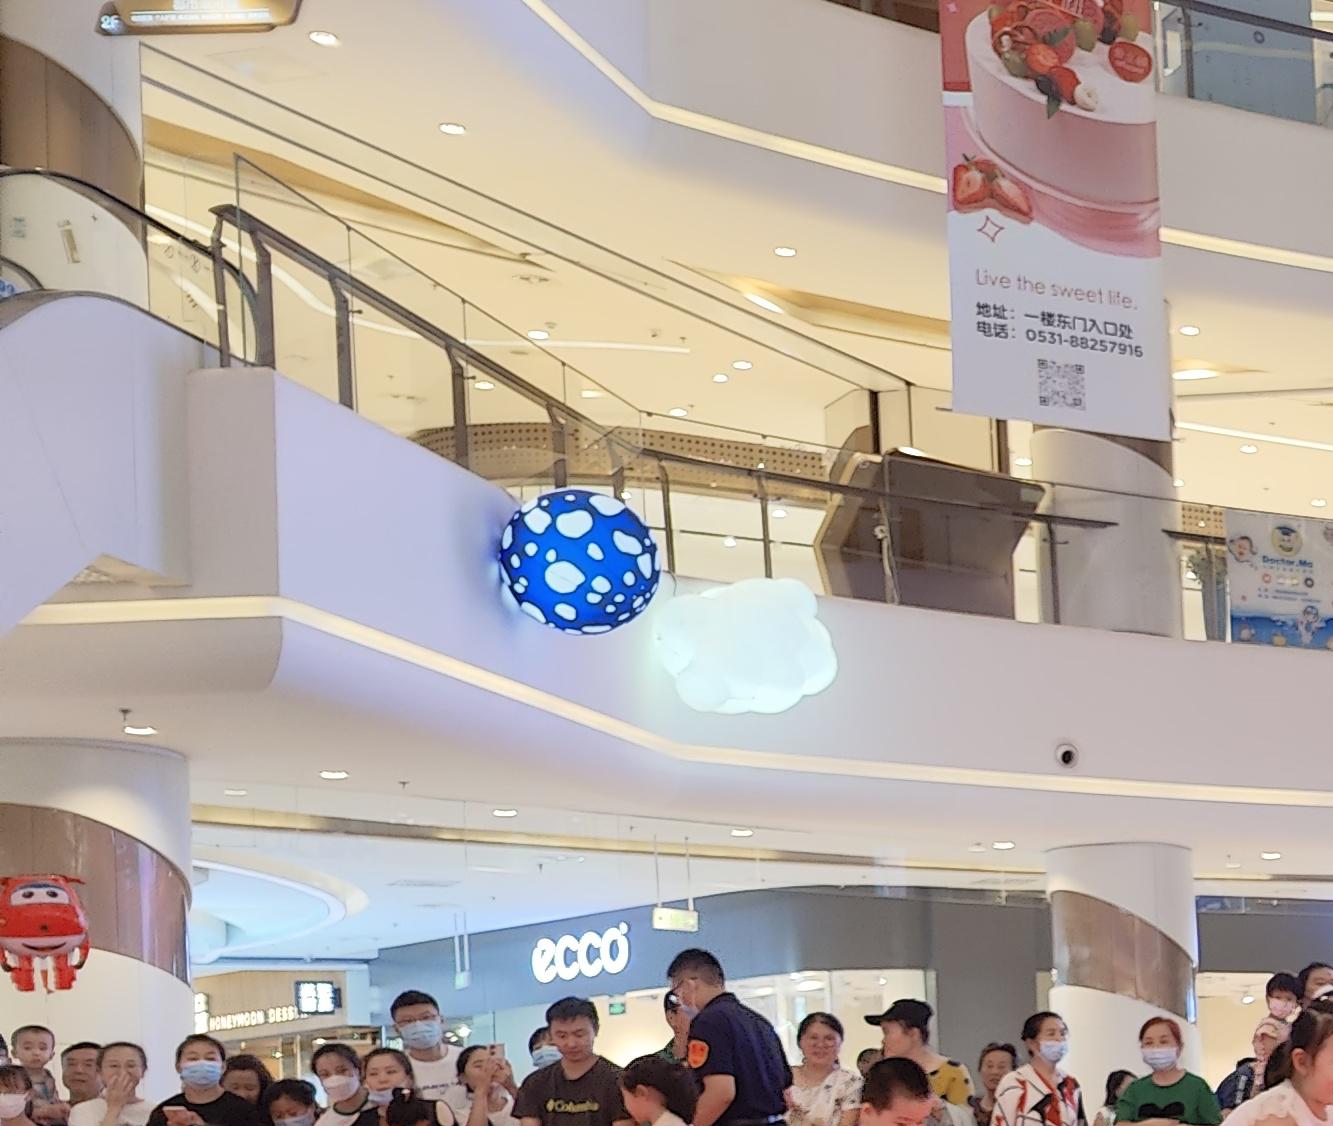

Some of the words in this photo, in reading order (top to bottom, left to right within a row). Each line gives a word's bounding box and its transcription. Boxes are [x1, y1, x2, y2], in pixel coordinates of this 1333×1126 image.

[976, 268, 1011, 289] Live
[1016, 274, 1045, 295] the
[1051, 283, 1103, 304] sweet
[1108, 289, 1138, 310] life.
[532, 921, 630, 984] ecco
[210, 1009, 266, 1031] HONEYMOON
[268, 1005, 309, 1025] DESS
